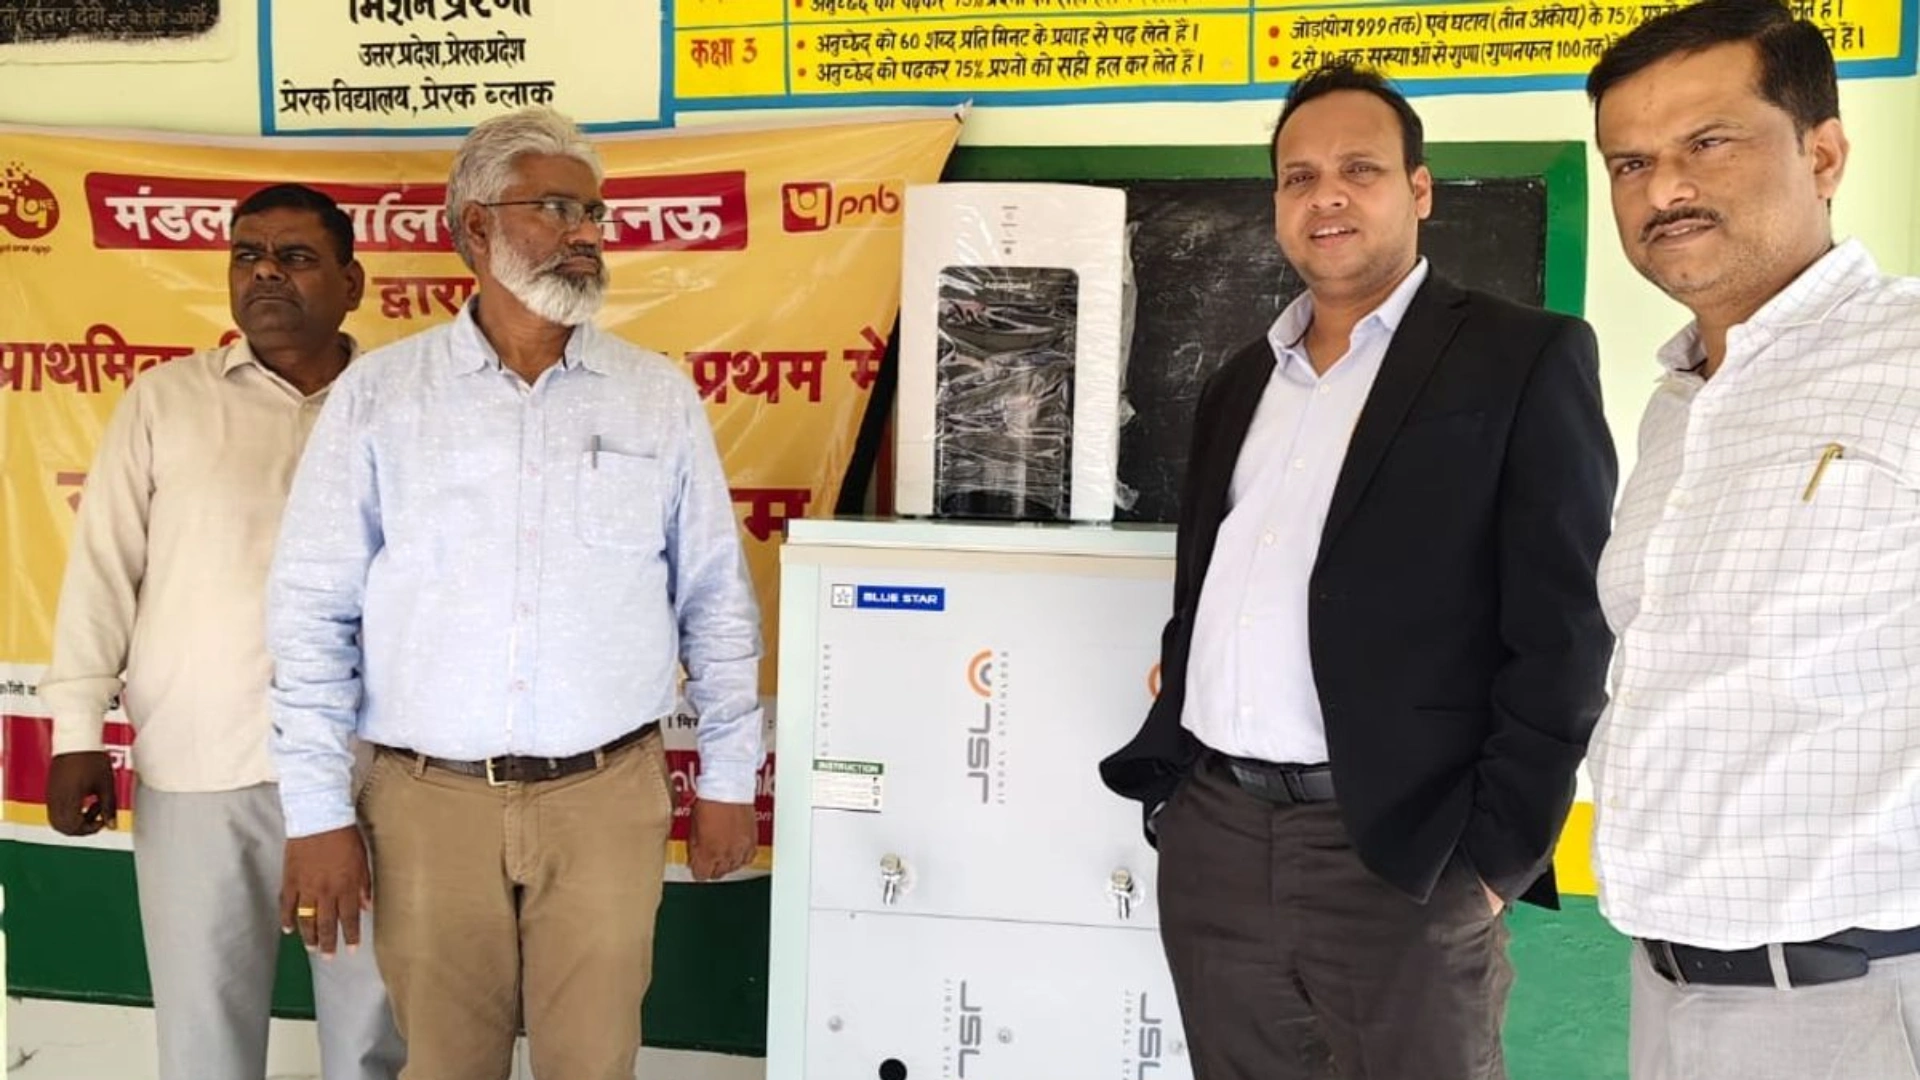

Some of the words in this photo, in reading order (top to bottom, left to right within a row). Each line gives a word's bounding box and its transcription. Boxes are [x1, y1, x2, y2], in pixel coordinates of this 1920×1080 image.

[900, 33, 920, 49] 60
[279, 79, 332, 115] प्रेरक
[420, 76, 477, 113] प्रेरक
[836, 183, 900, 225] pnb
[685, 351, 827, 403] प्रथम
[863, 592, 900, 603] BLUE
[902, 593, 938, 604] STAR
[967, 703, 992, 804] JSL
[958, 981, 982, 1078] JSL
